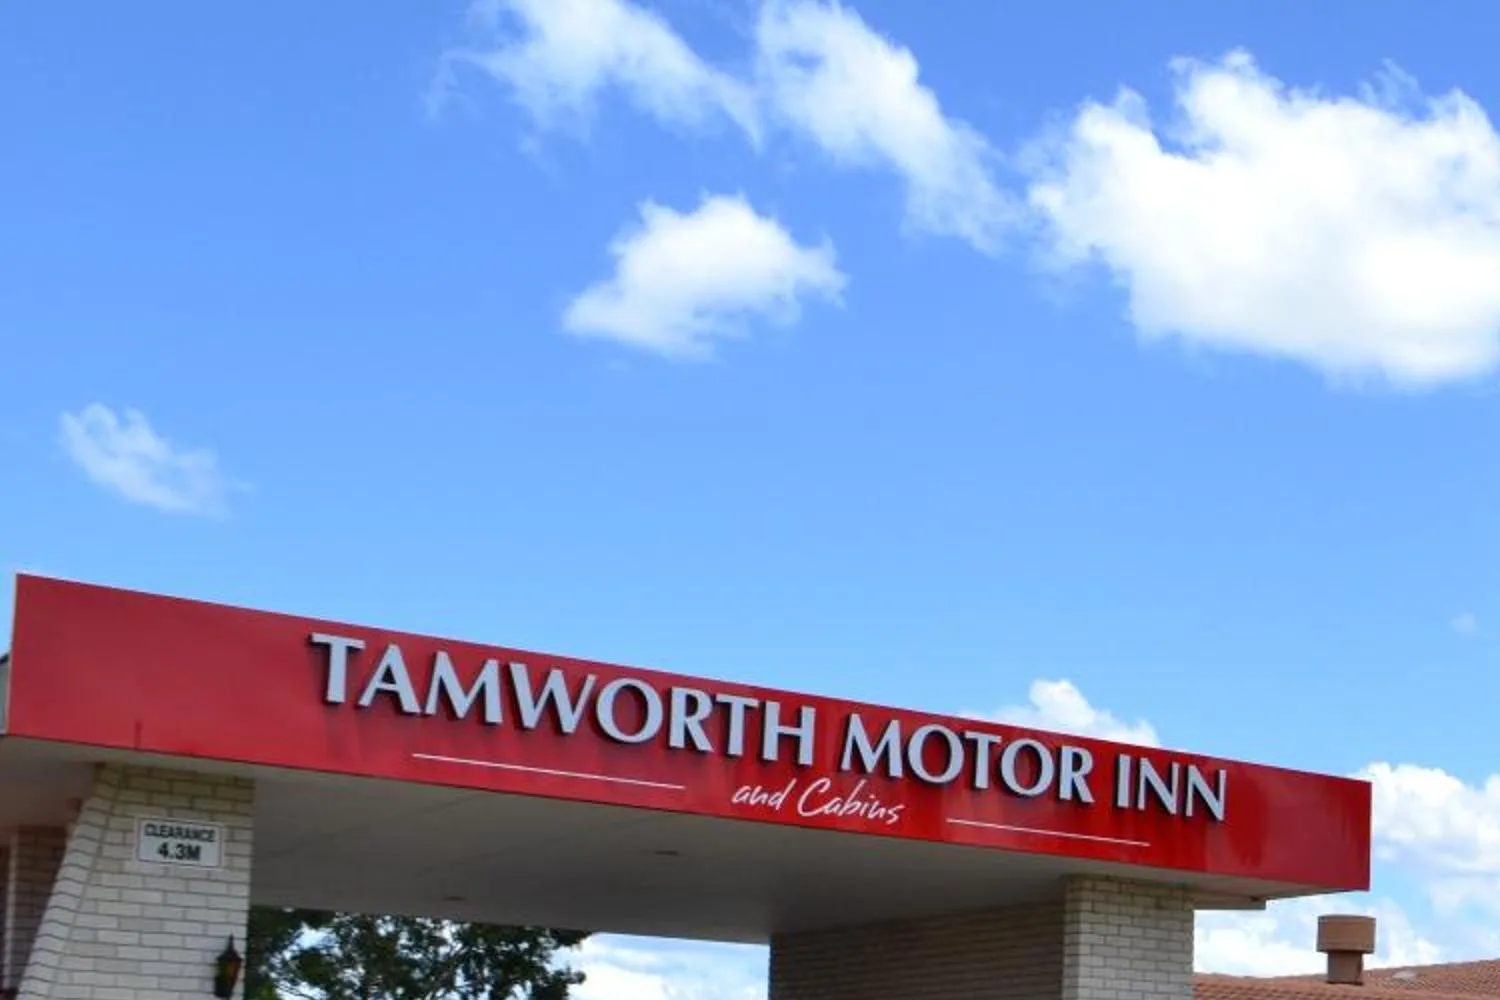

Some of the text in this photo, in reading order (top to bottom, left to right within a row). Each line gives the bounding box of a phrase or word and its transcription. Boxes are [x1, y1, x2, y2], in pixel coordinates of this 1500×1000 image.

[309, 632, 1227, 822] TAMWORTH MOTOR INN
[731, 777, 905, 825] and Cabins
